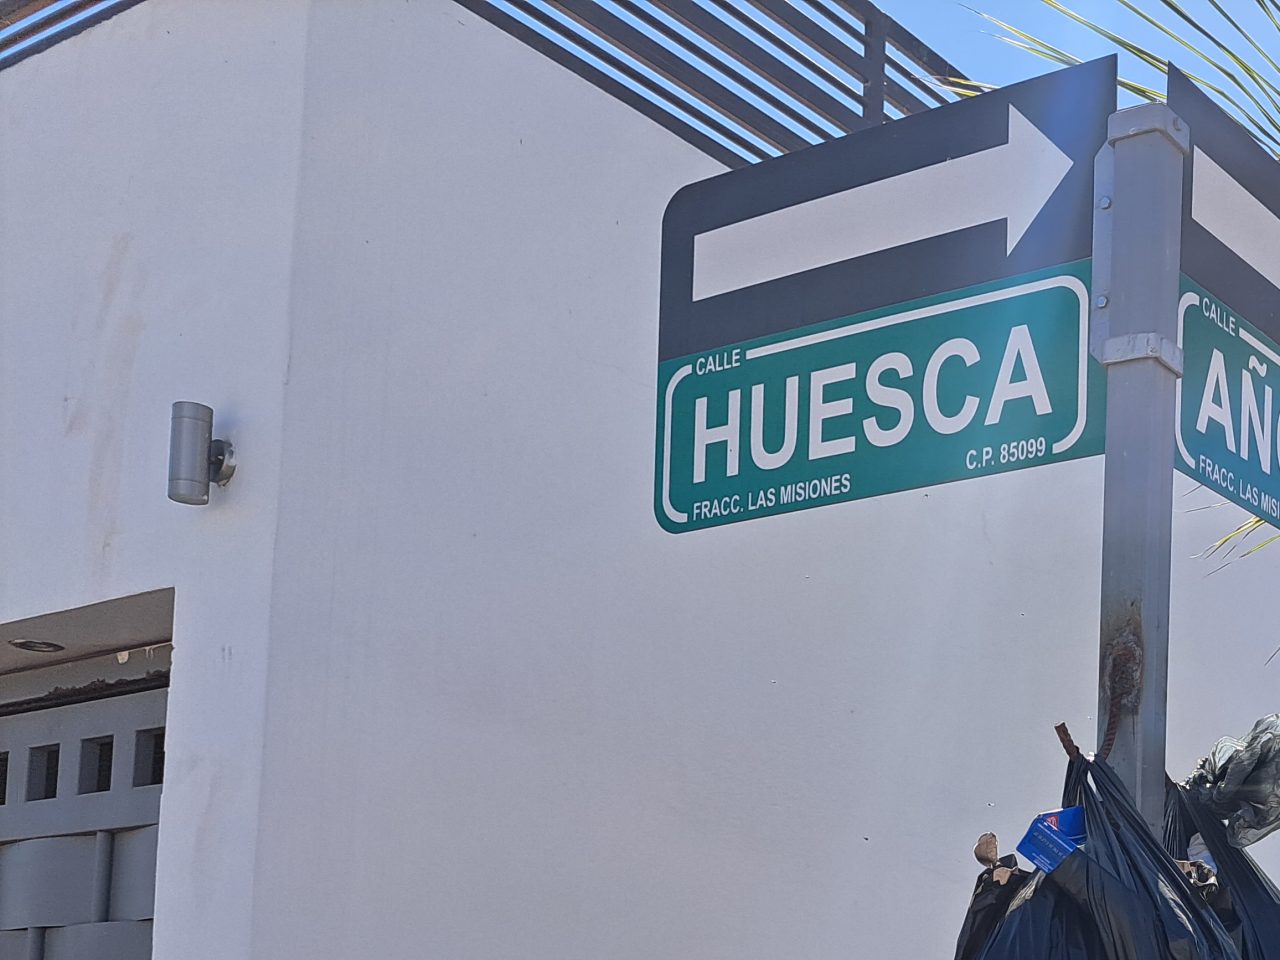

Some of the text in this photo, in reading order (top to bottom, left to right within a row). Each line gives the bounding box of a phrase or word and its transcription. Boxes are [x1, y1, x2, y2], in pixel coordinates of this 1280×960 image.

[1203, 297, 1236, 337] CALLE
[695, 349, 742, 376] CALLE
[693, 324, 1053, 484] HUESCA
[965, 436, 1046, 470] C.P. 85099
[693, 473, 851, 521] FRACC. LAS MISIONES
[1199, 454, 1237, 495] FRACC.
[1239, 479, 1259, 506] LAS
